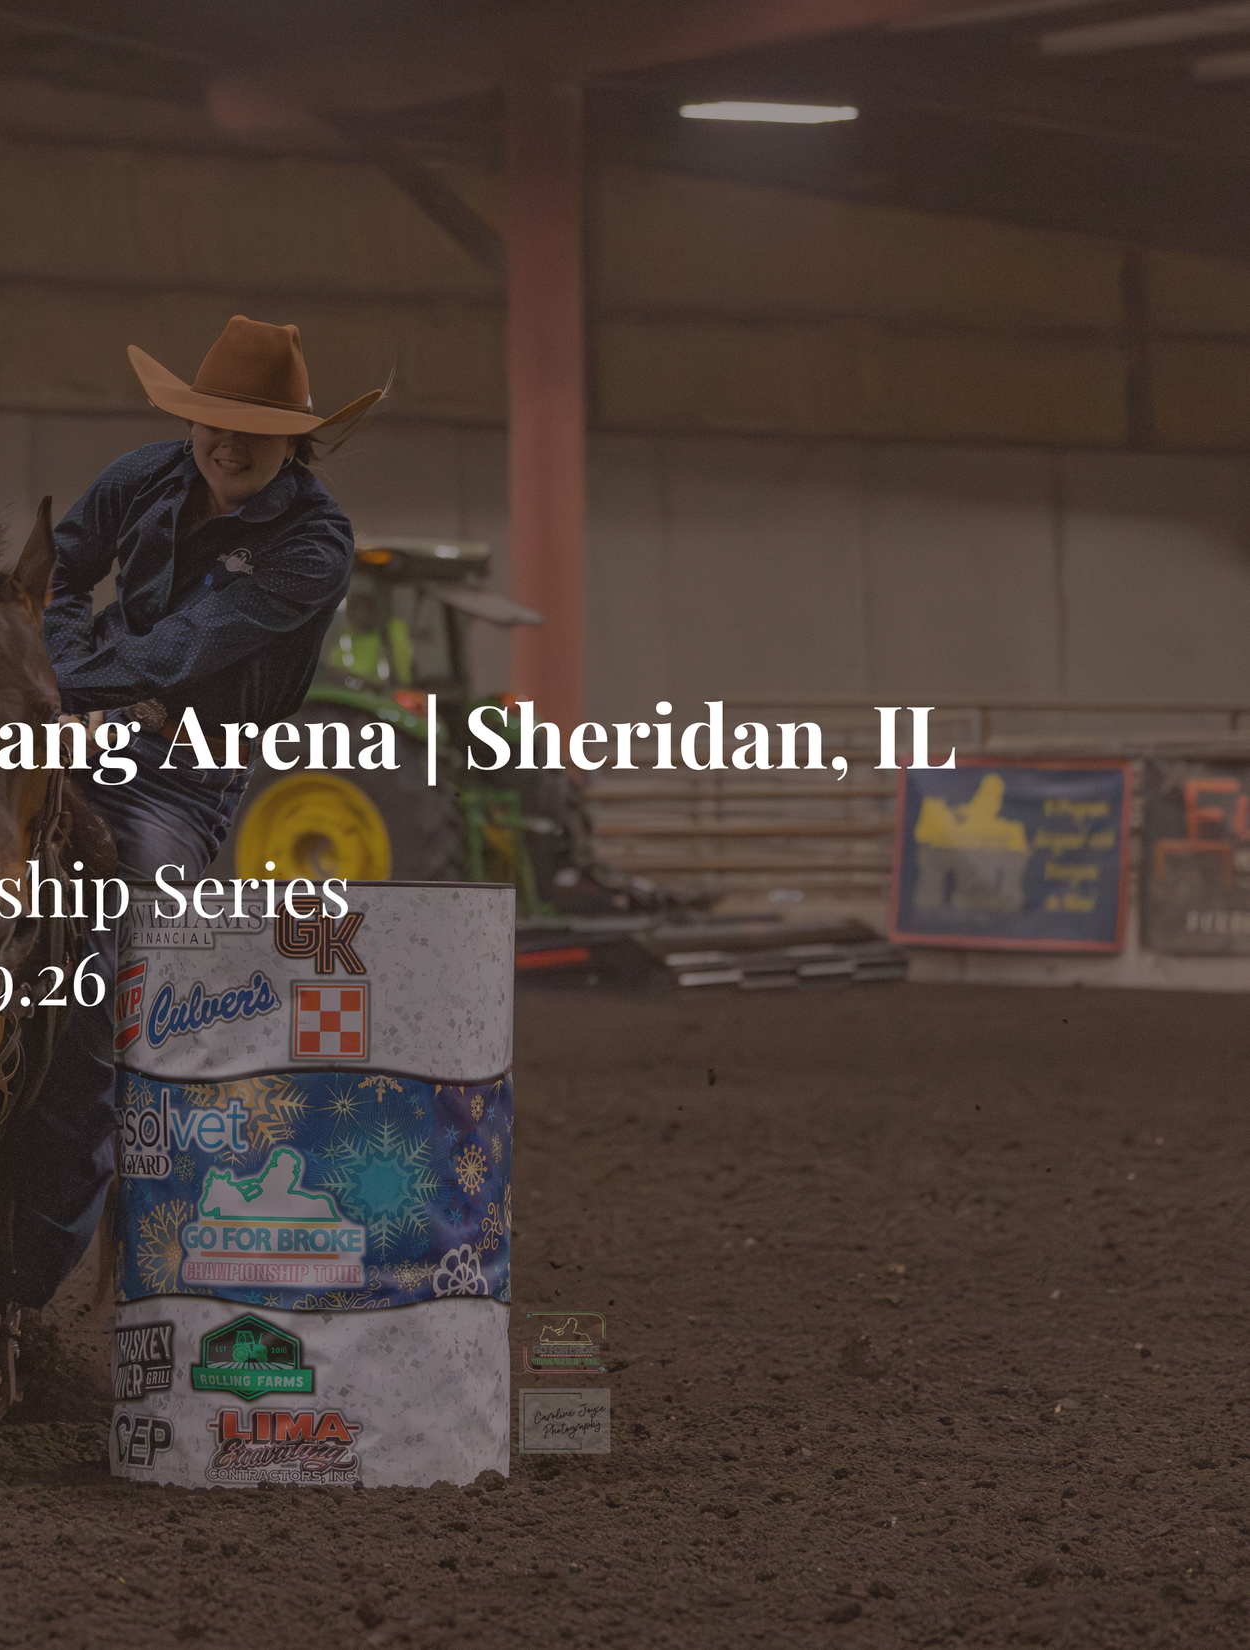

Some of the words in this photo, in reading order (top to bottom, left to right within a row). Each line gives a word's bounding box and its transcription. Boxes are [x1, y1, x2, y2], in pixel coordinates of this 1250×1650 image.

[130, 904, 262, 929] WILLIAMS
[133, 932, 211, 944] FINANCIAL
[275, 897, 367, 974] GK
[148, 974, 275, 1046] Culver's
[184, 1226, 217, 1249] GO
[222, 1227, 271, 1250] FOR
[277, 1228, 362, 1252] BROKE
[184, 1261, 309, 1283] CHAMPIONSHIP
[314, 1264, 361, 1283] TOUR
[146, 1370, 170, 1385] GRILL
[200, 1374, 250, 1386] ROLLING
[257, 1375, 304, 1387] FARMS
[115, 1412, 174, 1469] CEP
[218, 1411, 354, 1445] LIMA
[212, 1437, 357, 1474] Excavating
[208, 1468, 326, 1483] CONTRACTORS,
[328, 1470, 359, 1483] INC.
